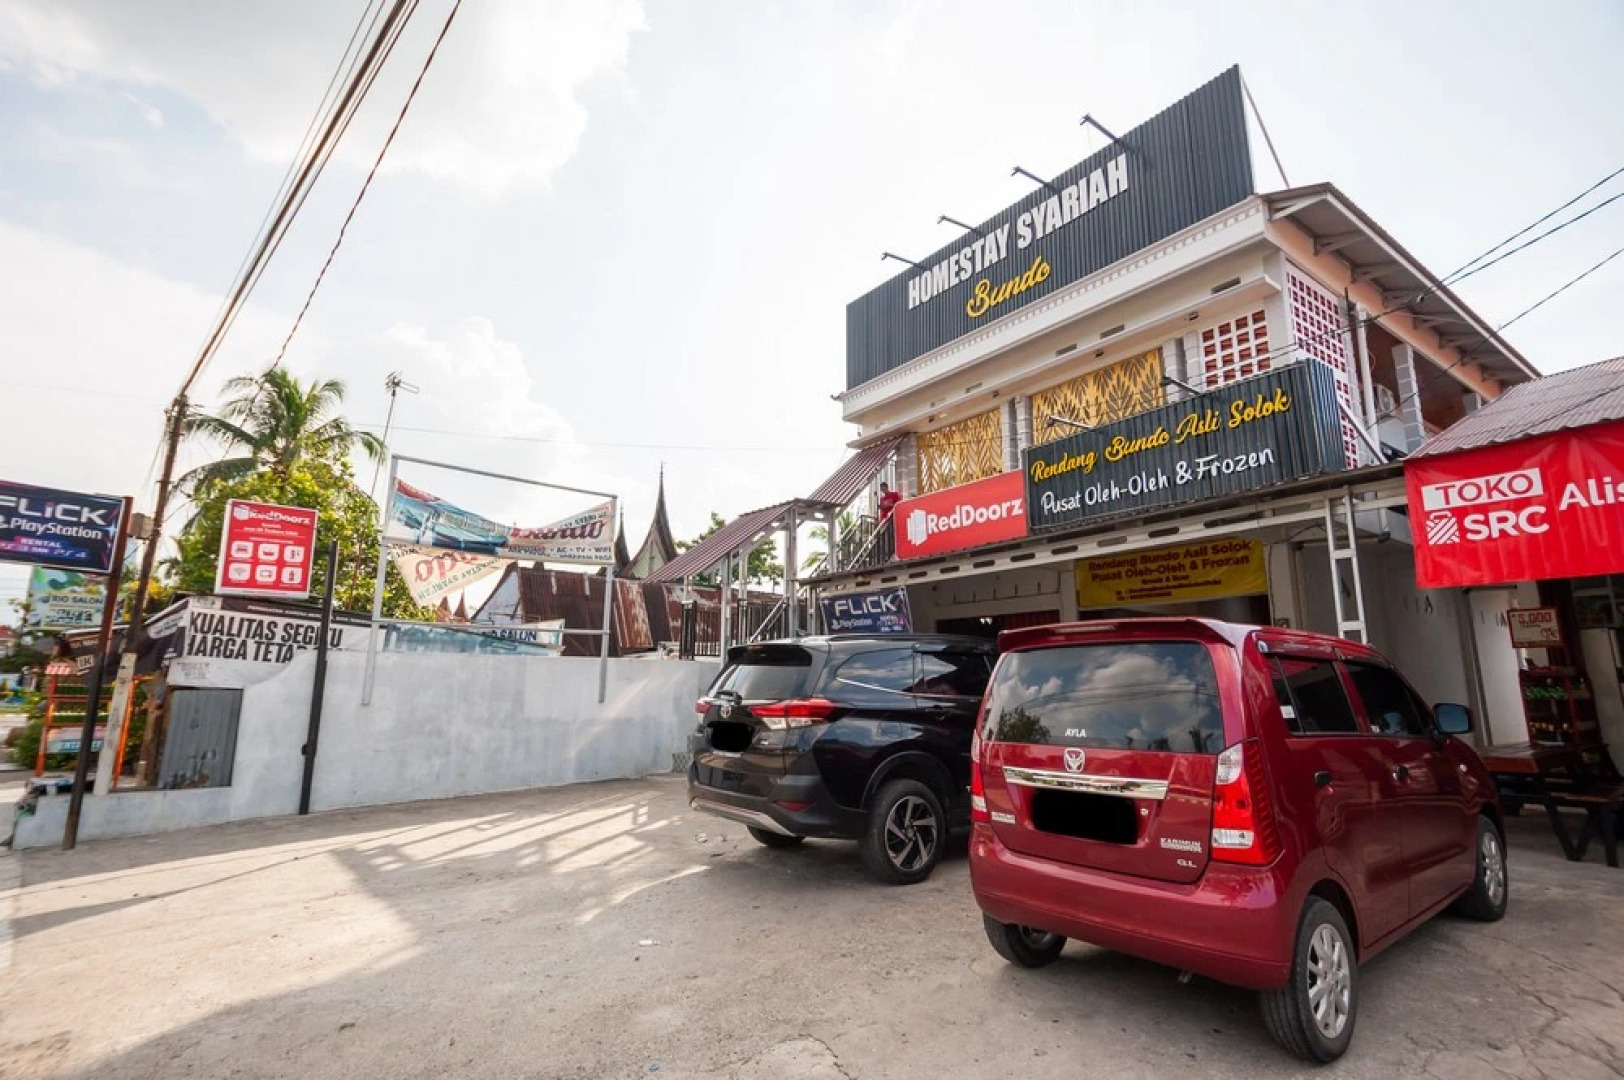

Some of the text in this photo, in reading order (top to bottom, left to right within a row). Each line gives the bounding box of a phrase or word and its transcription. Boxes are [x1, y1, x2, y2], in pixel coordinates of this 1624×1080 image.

[908, 152, 1128, 311] HOMESTAY SYARIAH
[965, 255, 1051, 318] Bundo
[1030, 388, 1292, 483] Rendang Bundo Asli Solok
[1041, 447, 1274, 515] Pusat Oleh-Oleh & Frozen
[1436, 472, 1534, 506] TOKO
[10, 517, 102, 539] PlayStation
[926, 498, 1024, 534] RedDoorz
[1463, 506, 1550, 542] SRC
[20, 537, 62, 548] RENTAL
[1088, 540, 1251, 572] Rendang Bundo Asli Solok
[1091, 570, 1123, 582] Pusat
[1124, 561, 1186, 579] Oleh-Oleh
[1189, 560, 1198, 571] &
[190, 611, 278, 641] KUALITAS
[280, 622, 343, 647] SEGIU
[253, 640, 307, 663] TETA
